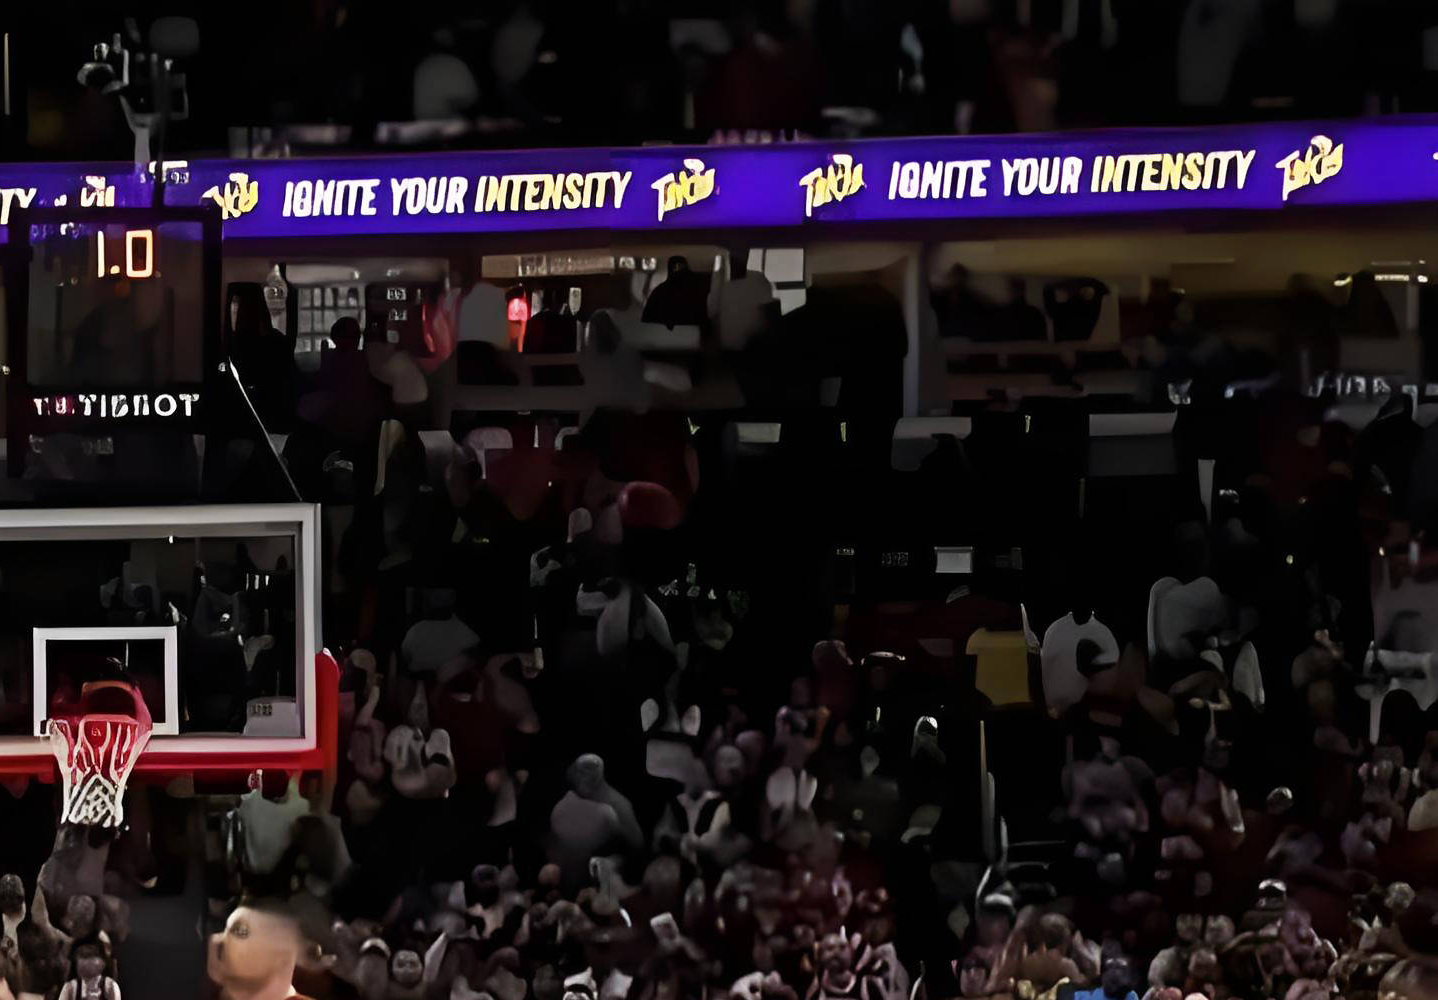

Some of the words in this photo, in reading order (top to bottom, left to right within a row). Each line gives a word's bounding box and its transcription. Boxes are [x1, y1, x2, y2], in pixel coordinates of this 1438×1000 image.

[282, 178, 381, 218] IGNITE
[390, 176, 468, 216] YOUR
[474, 170, 633, 213] INTENSITY
[888, 159, 992, 201] IGNITE
[1001, 156, 1083, 197] YOUR
[1090, 149, 1257, 193] INTENSITY
[96, 229, 154, 278] 1.0
